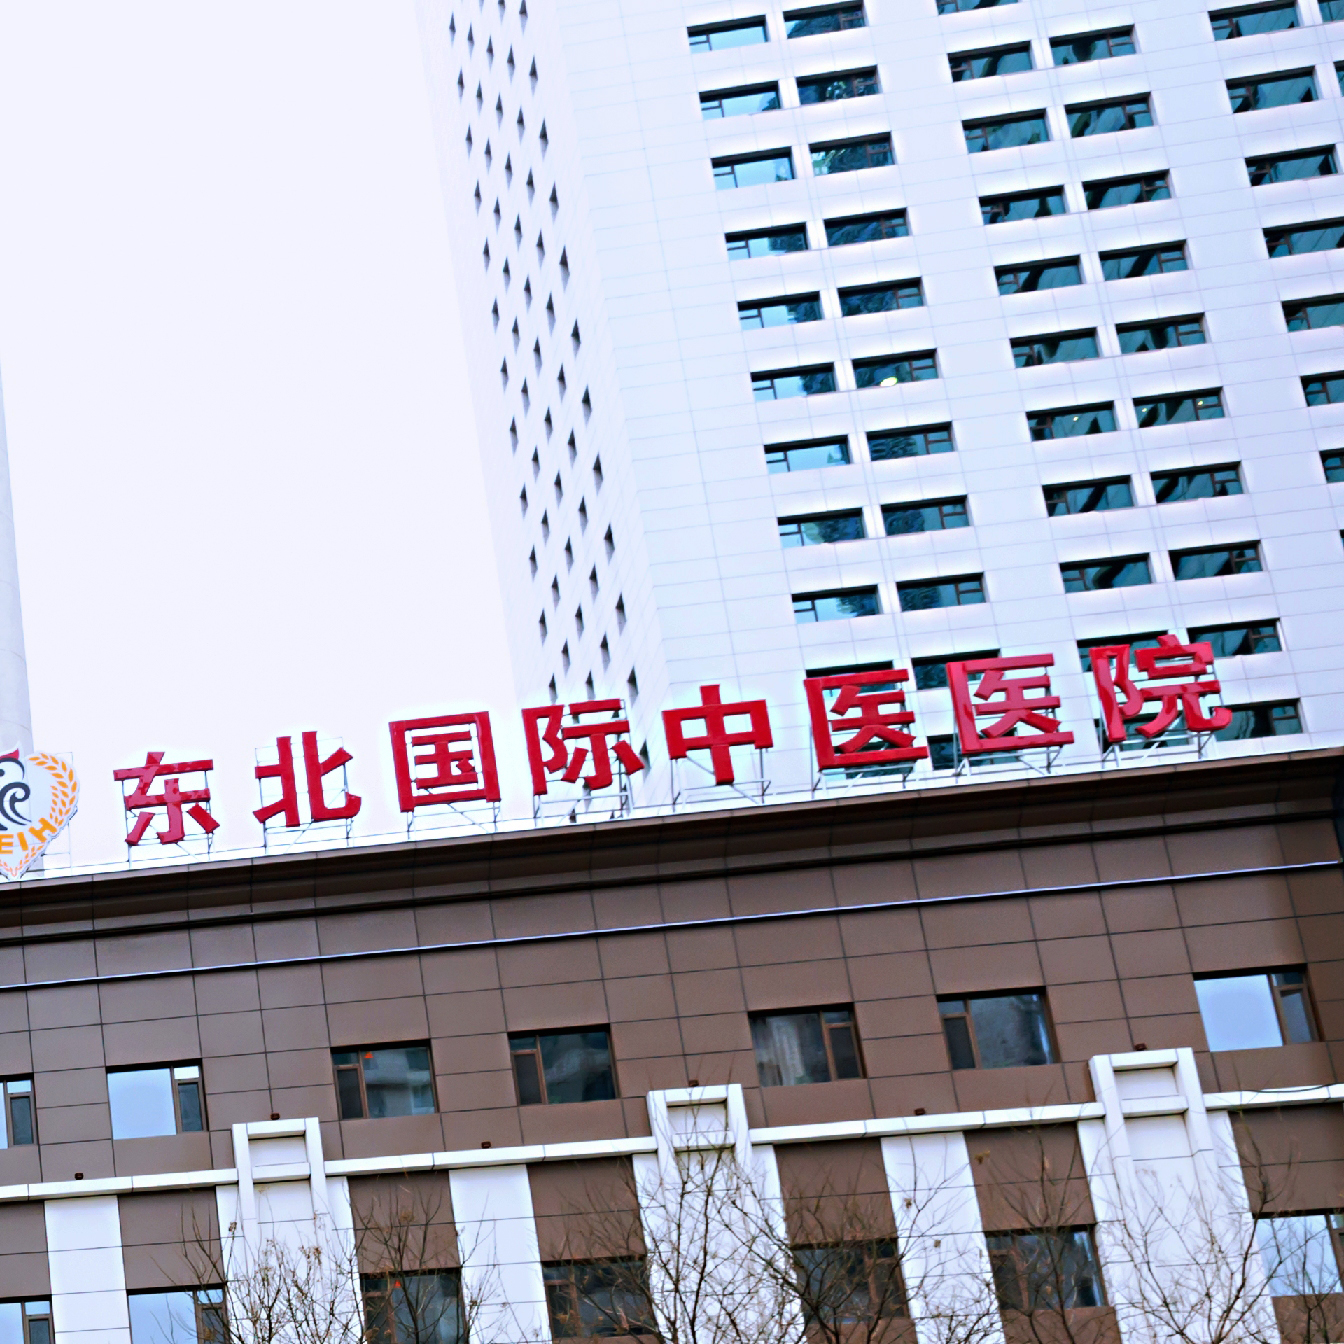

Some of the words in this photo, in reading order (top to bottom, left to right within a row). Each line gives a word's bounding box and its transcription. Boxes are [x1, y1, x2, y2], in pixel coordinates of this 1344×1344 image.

[113, 634, 1234, 846] 东北国际中医医院
